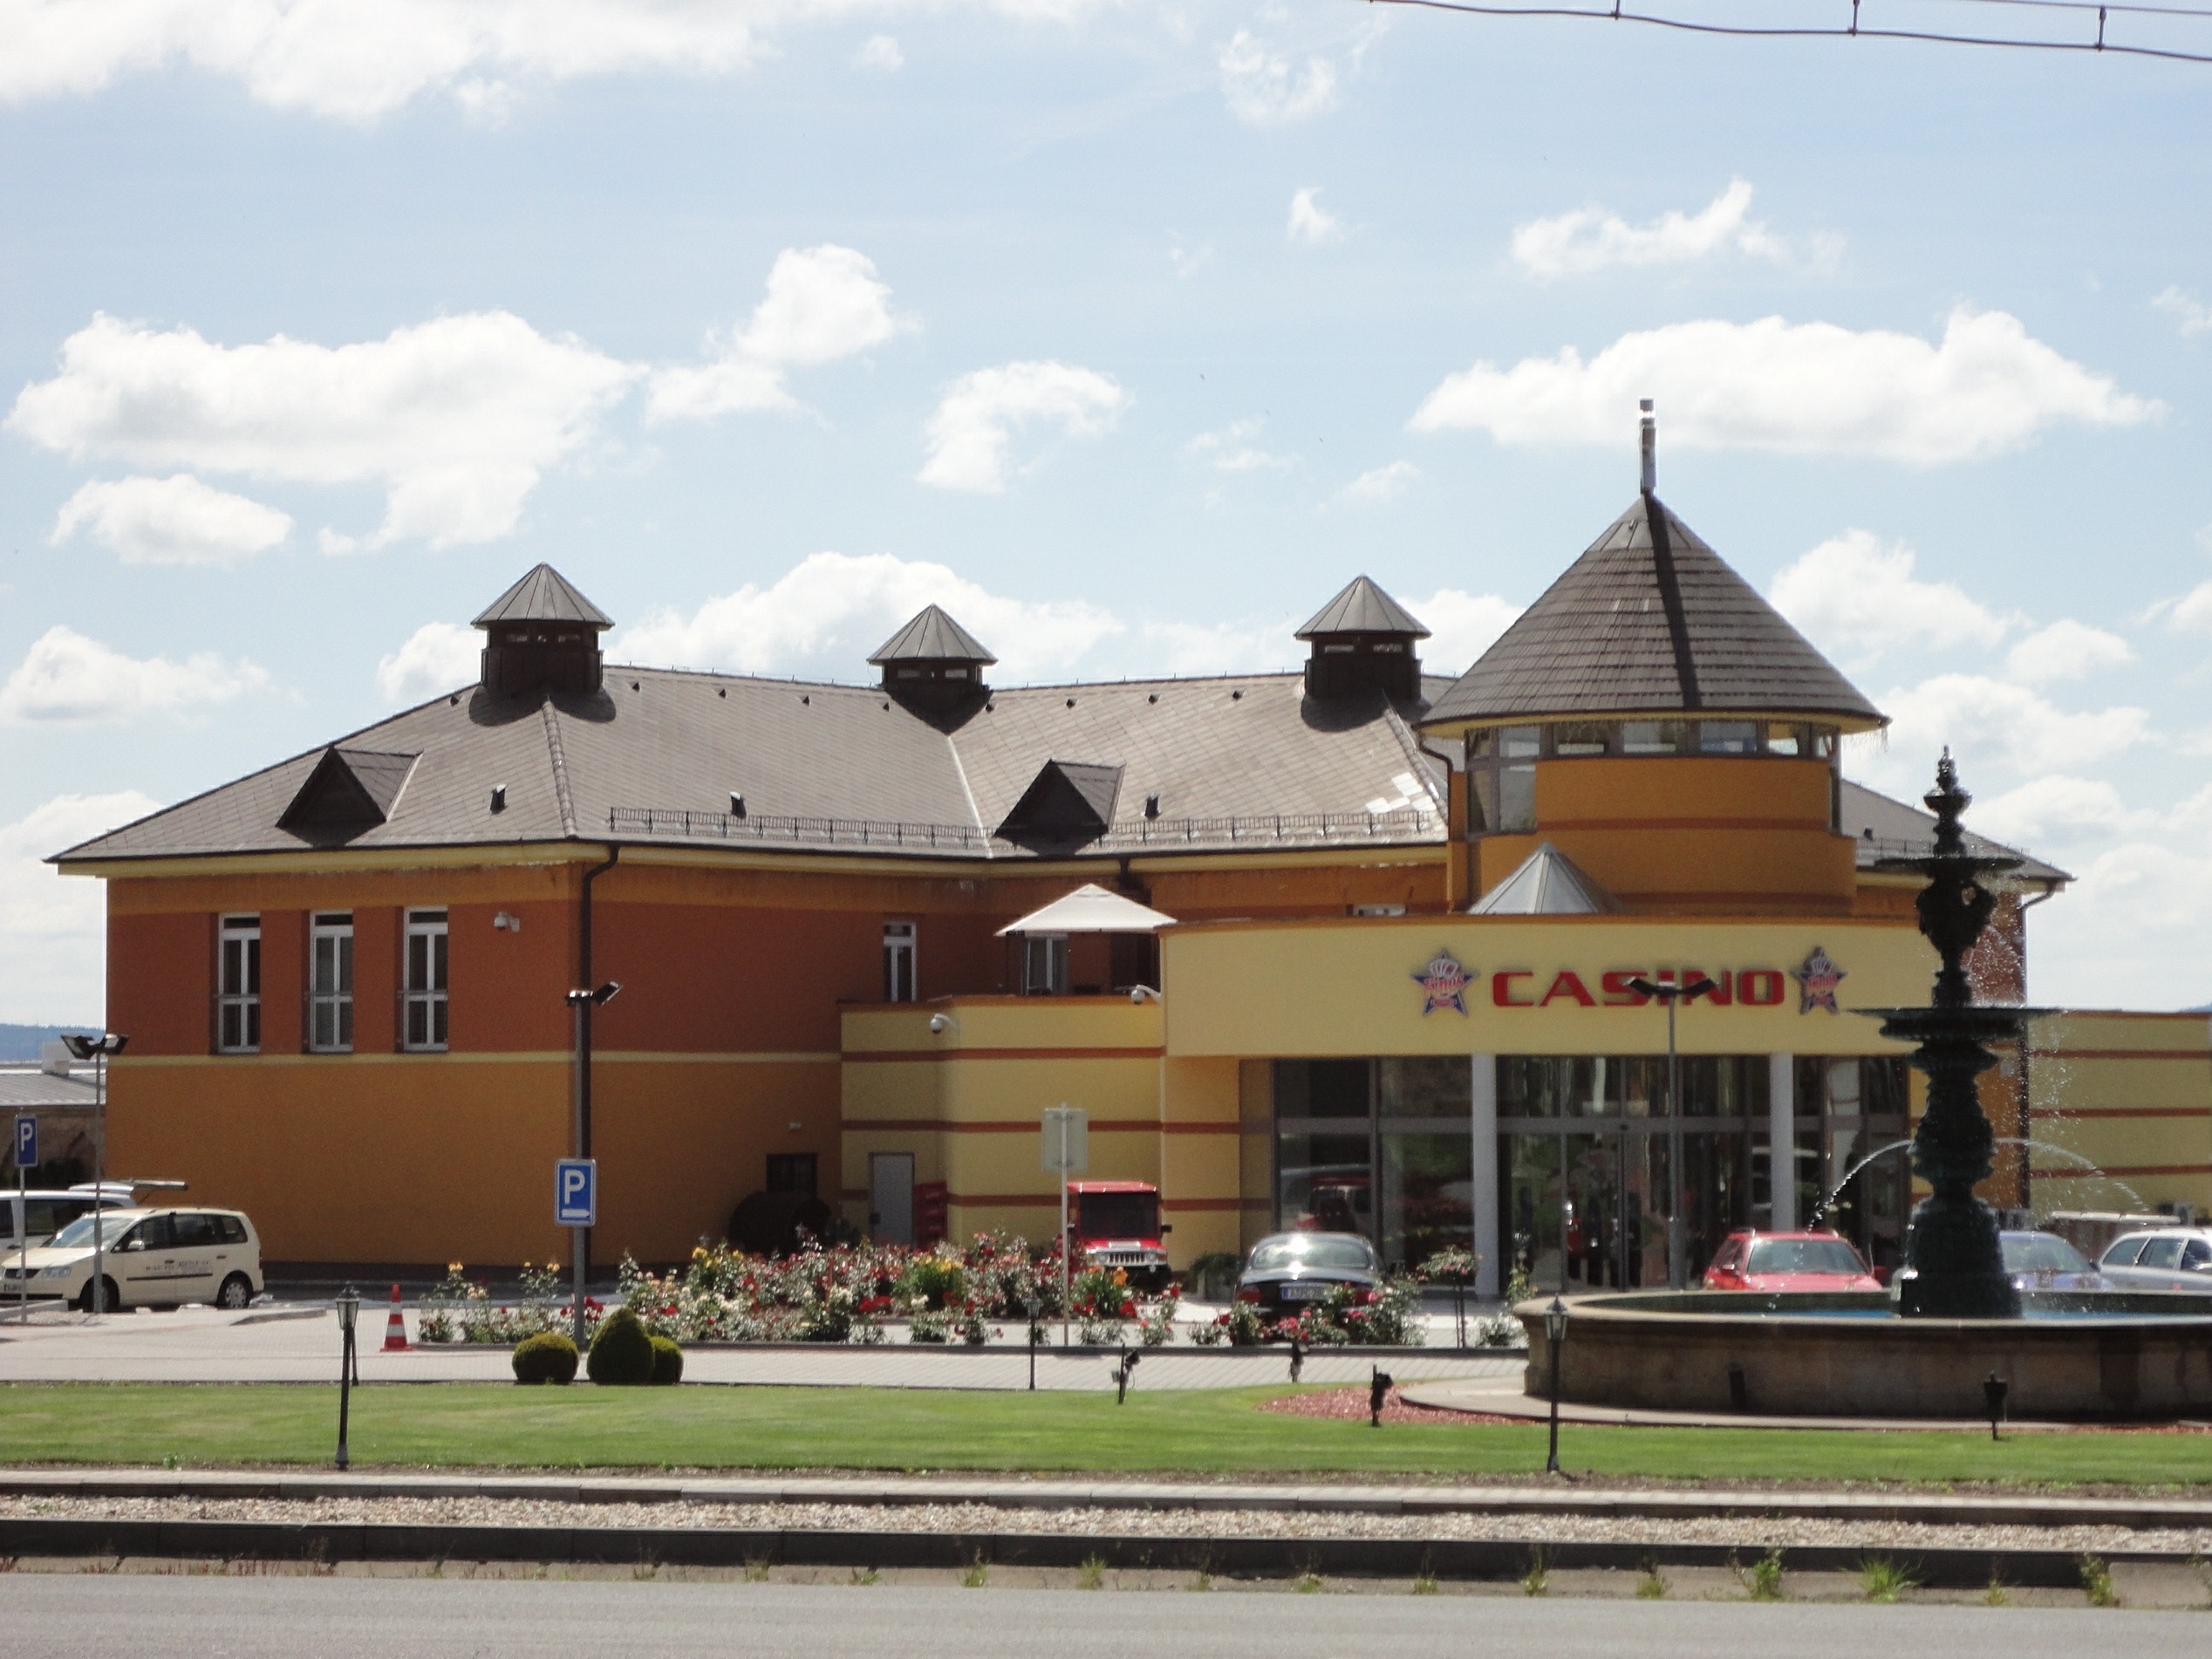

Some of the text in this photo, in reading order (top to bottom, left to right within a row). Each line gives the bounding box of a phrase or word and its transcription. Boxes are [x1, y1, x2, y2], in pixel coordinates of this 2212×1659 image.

[1493, 970, 1785, 1007] CASINO
[20, 1122, 32, 1152] P
[564, 1169, 585, 1205] P
